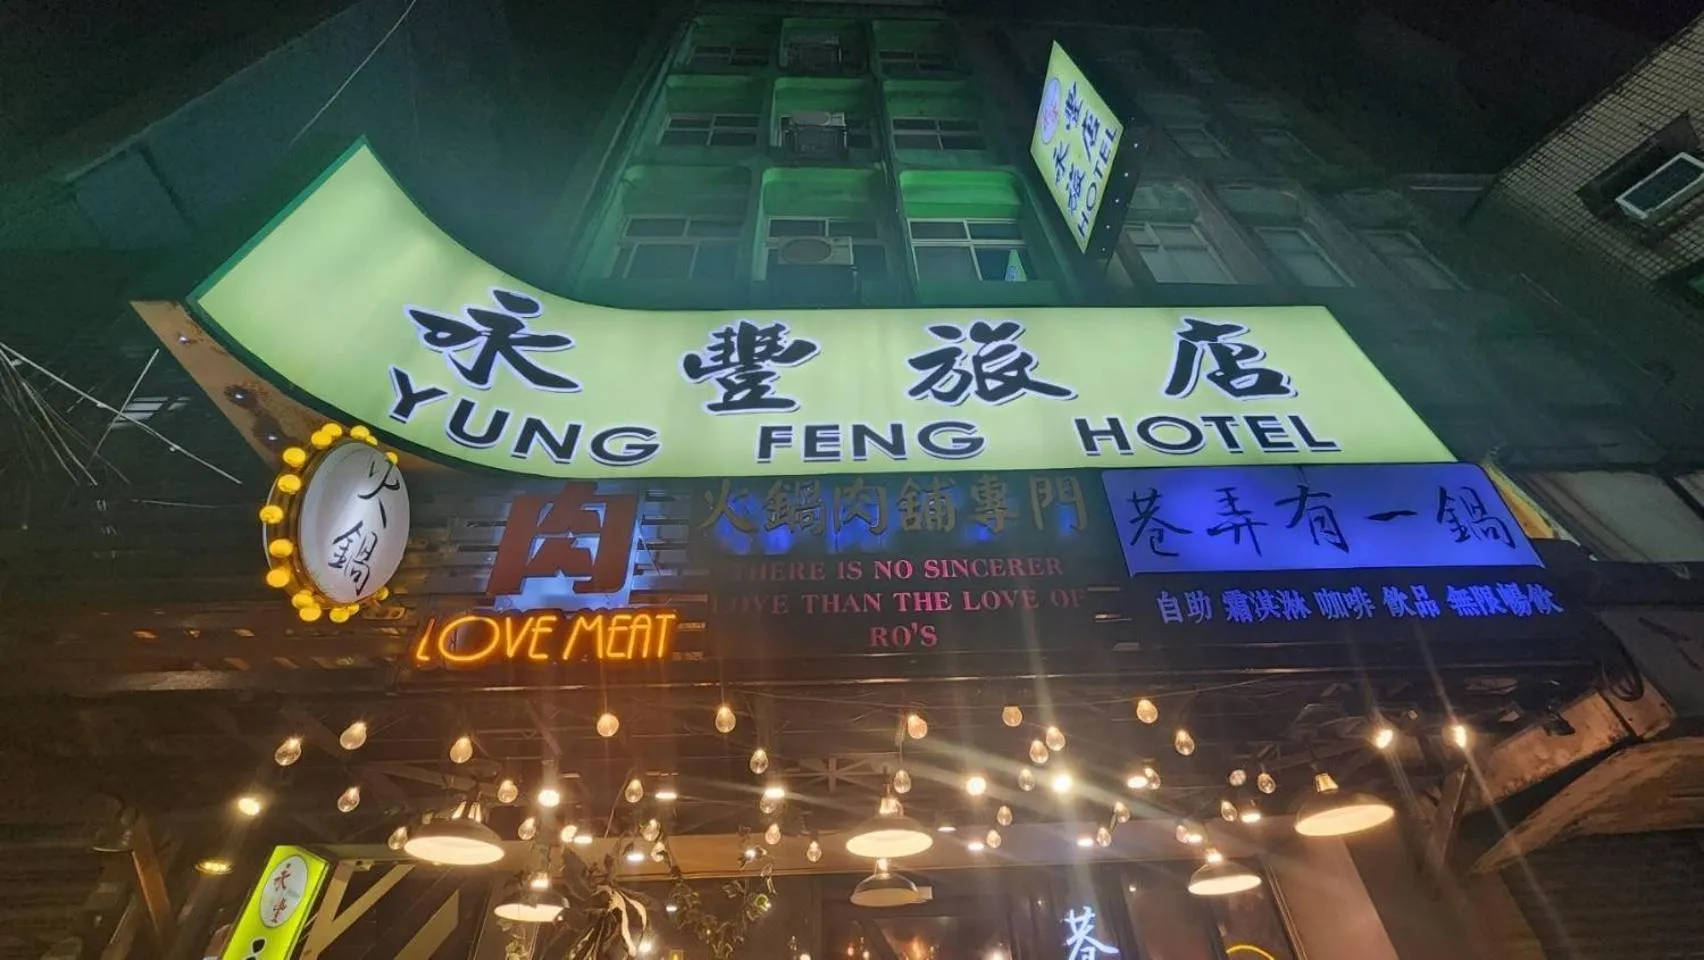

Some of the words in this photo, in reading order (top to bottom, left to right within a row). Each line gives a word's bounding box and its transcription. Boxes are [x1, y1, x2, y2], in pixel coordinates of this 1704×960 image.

[1077, 125, 1118, 239] HOTEL
[388, 365, 661, 466] YUNG
[756, 420, 986, 464] FENG
[1073, 414, 1343, 457] HOTEL
[328, 458, 400, 597] 火鍋
[837, 560, 863, 581] IS
[874, 559, 914, 581] NO
[923, 556, 1064, 580] SINCERER
[802, 591, 882, 615] THAN
[893, 590, 952, 613] THE
[963, 588, 1040, 613] LOVE
[1050, 587, 1087, 608] OF
[1156, 590, 1213, 624] 自助
[1222, 588, 1312, 623] 霜淇淋
[1313, 584, 1376, 620] 咖啡
[1382, 583, 1442, 619] 飲品
[415, 615, 558, 662] LOVE
[562, 613, 677, 661] MEAT
[869, 621, 938, 648] RO'S
